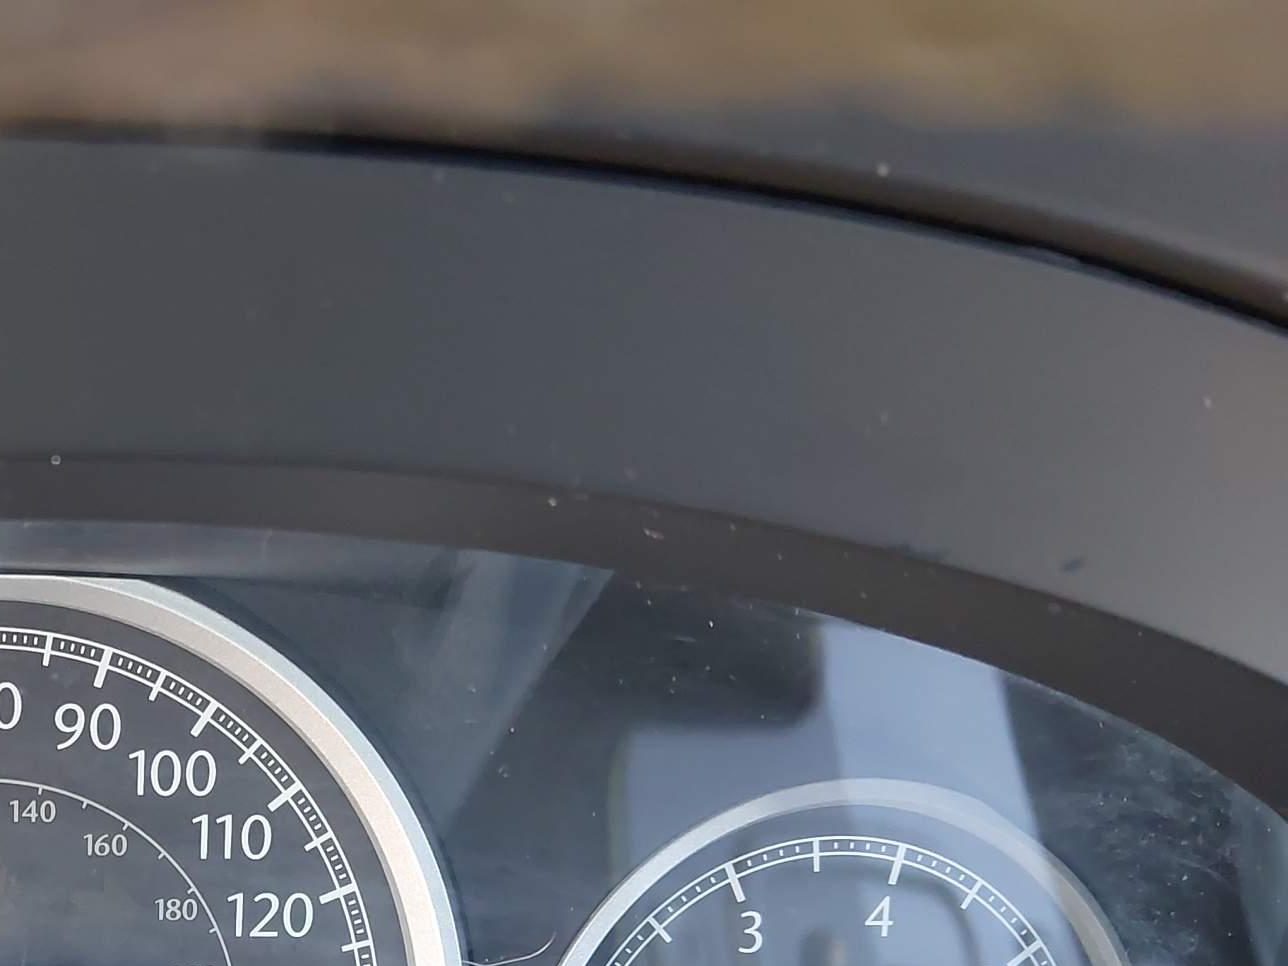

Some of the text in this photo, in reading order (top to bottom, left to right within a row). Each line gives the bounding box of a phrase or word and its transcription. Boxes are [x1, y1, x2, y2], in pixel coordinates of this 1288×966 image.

[54, 703, 122, 751] 90
[128, 749, 217, 797] 100
[9, 799, 56, 823] 140
[83, 833, 128, 857] 160
[191, 814, 272, 860] 110
[154, 898, 198, 921] 180
[227, 892, 314, 938] 120
[864, 895, 894, 937] 4
[738, 910, 763, 954] 3
